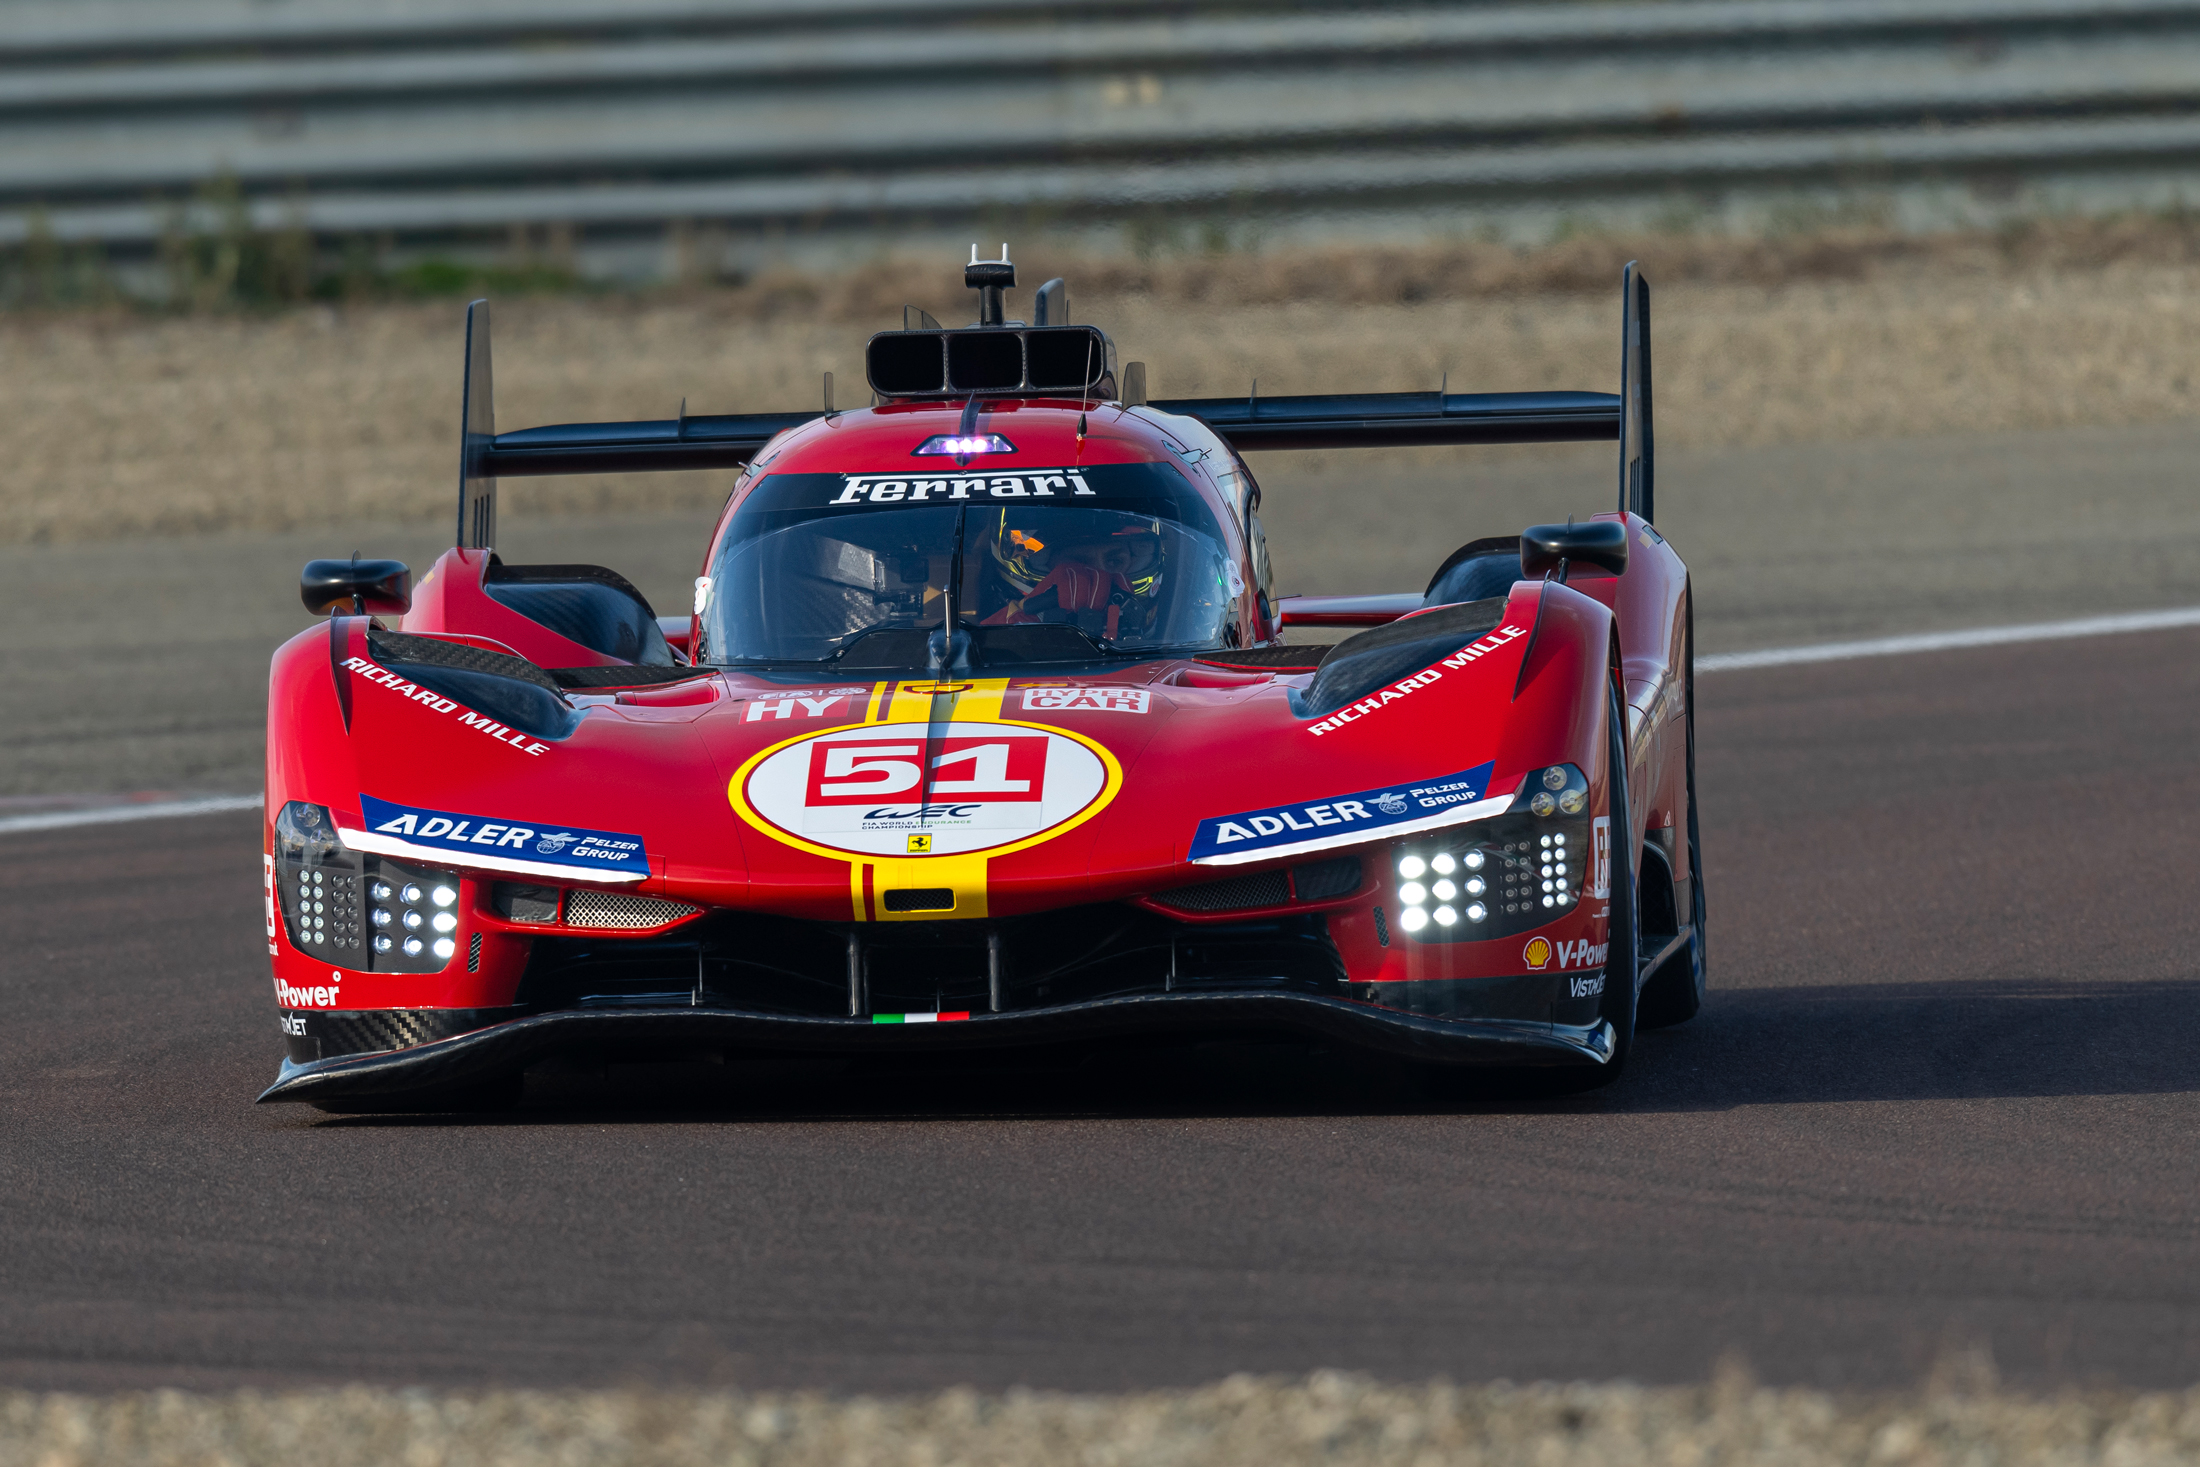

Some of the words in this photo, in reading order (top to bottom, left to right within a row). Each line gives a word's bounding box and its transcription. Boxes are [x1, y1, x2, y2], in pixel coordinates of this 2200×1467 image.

[829, 469, 1096, 504] Ferrari
[1307, 669, 1443, 736] RICHARD
[1441, 625, 1528, 670] MILLE
[1030, 696, 1140, 711] CAR
[1031, 689, 1142, 698] HYPER
[339, 656, 458, 714] RICHARD
[457, 711, 551, 756] MILLE
[746, 696, 845, 722] HY
[820, 743, 1032, 797] 51
[1409, 781, 1470, 798] PELZER
[1418, 791, 1477, 808] GROUP
[863, 804, 982, 820] WEC
[1215, 800, 1373, 845] ADLER
[375, 813, 534, 849] ADLER
[572, 846, 629, 861] GROUP
[580, 836, 639, 851] PELZER
